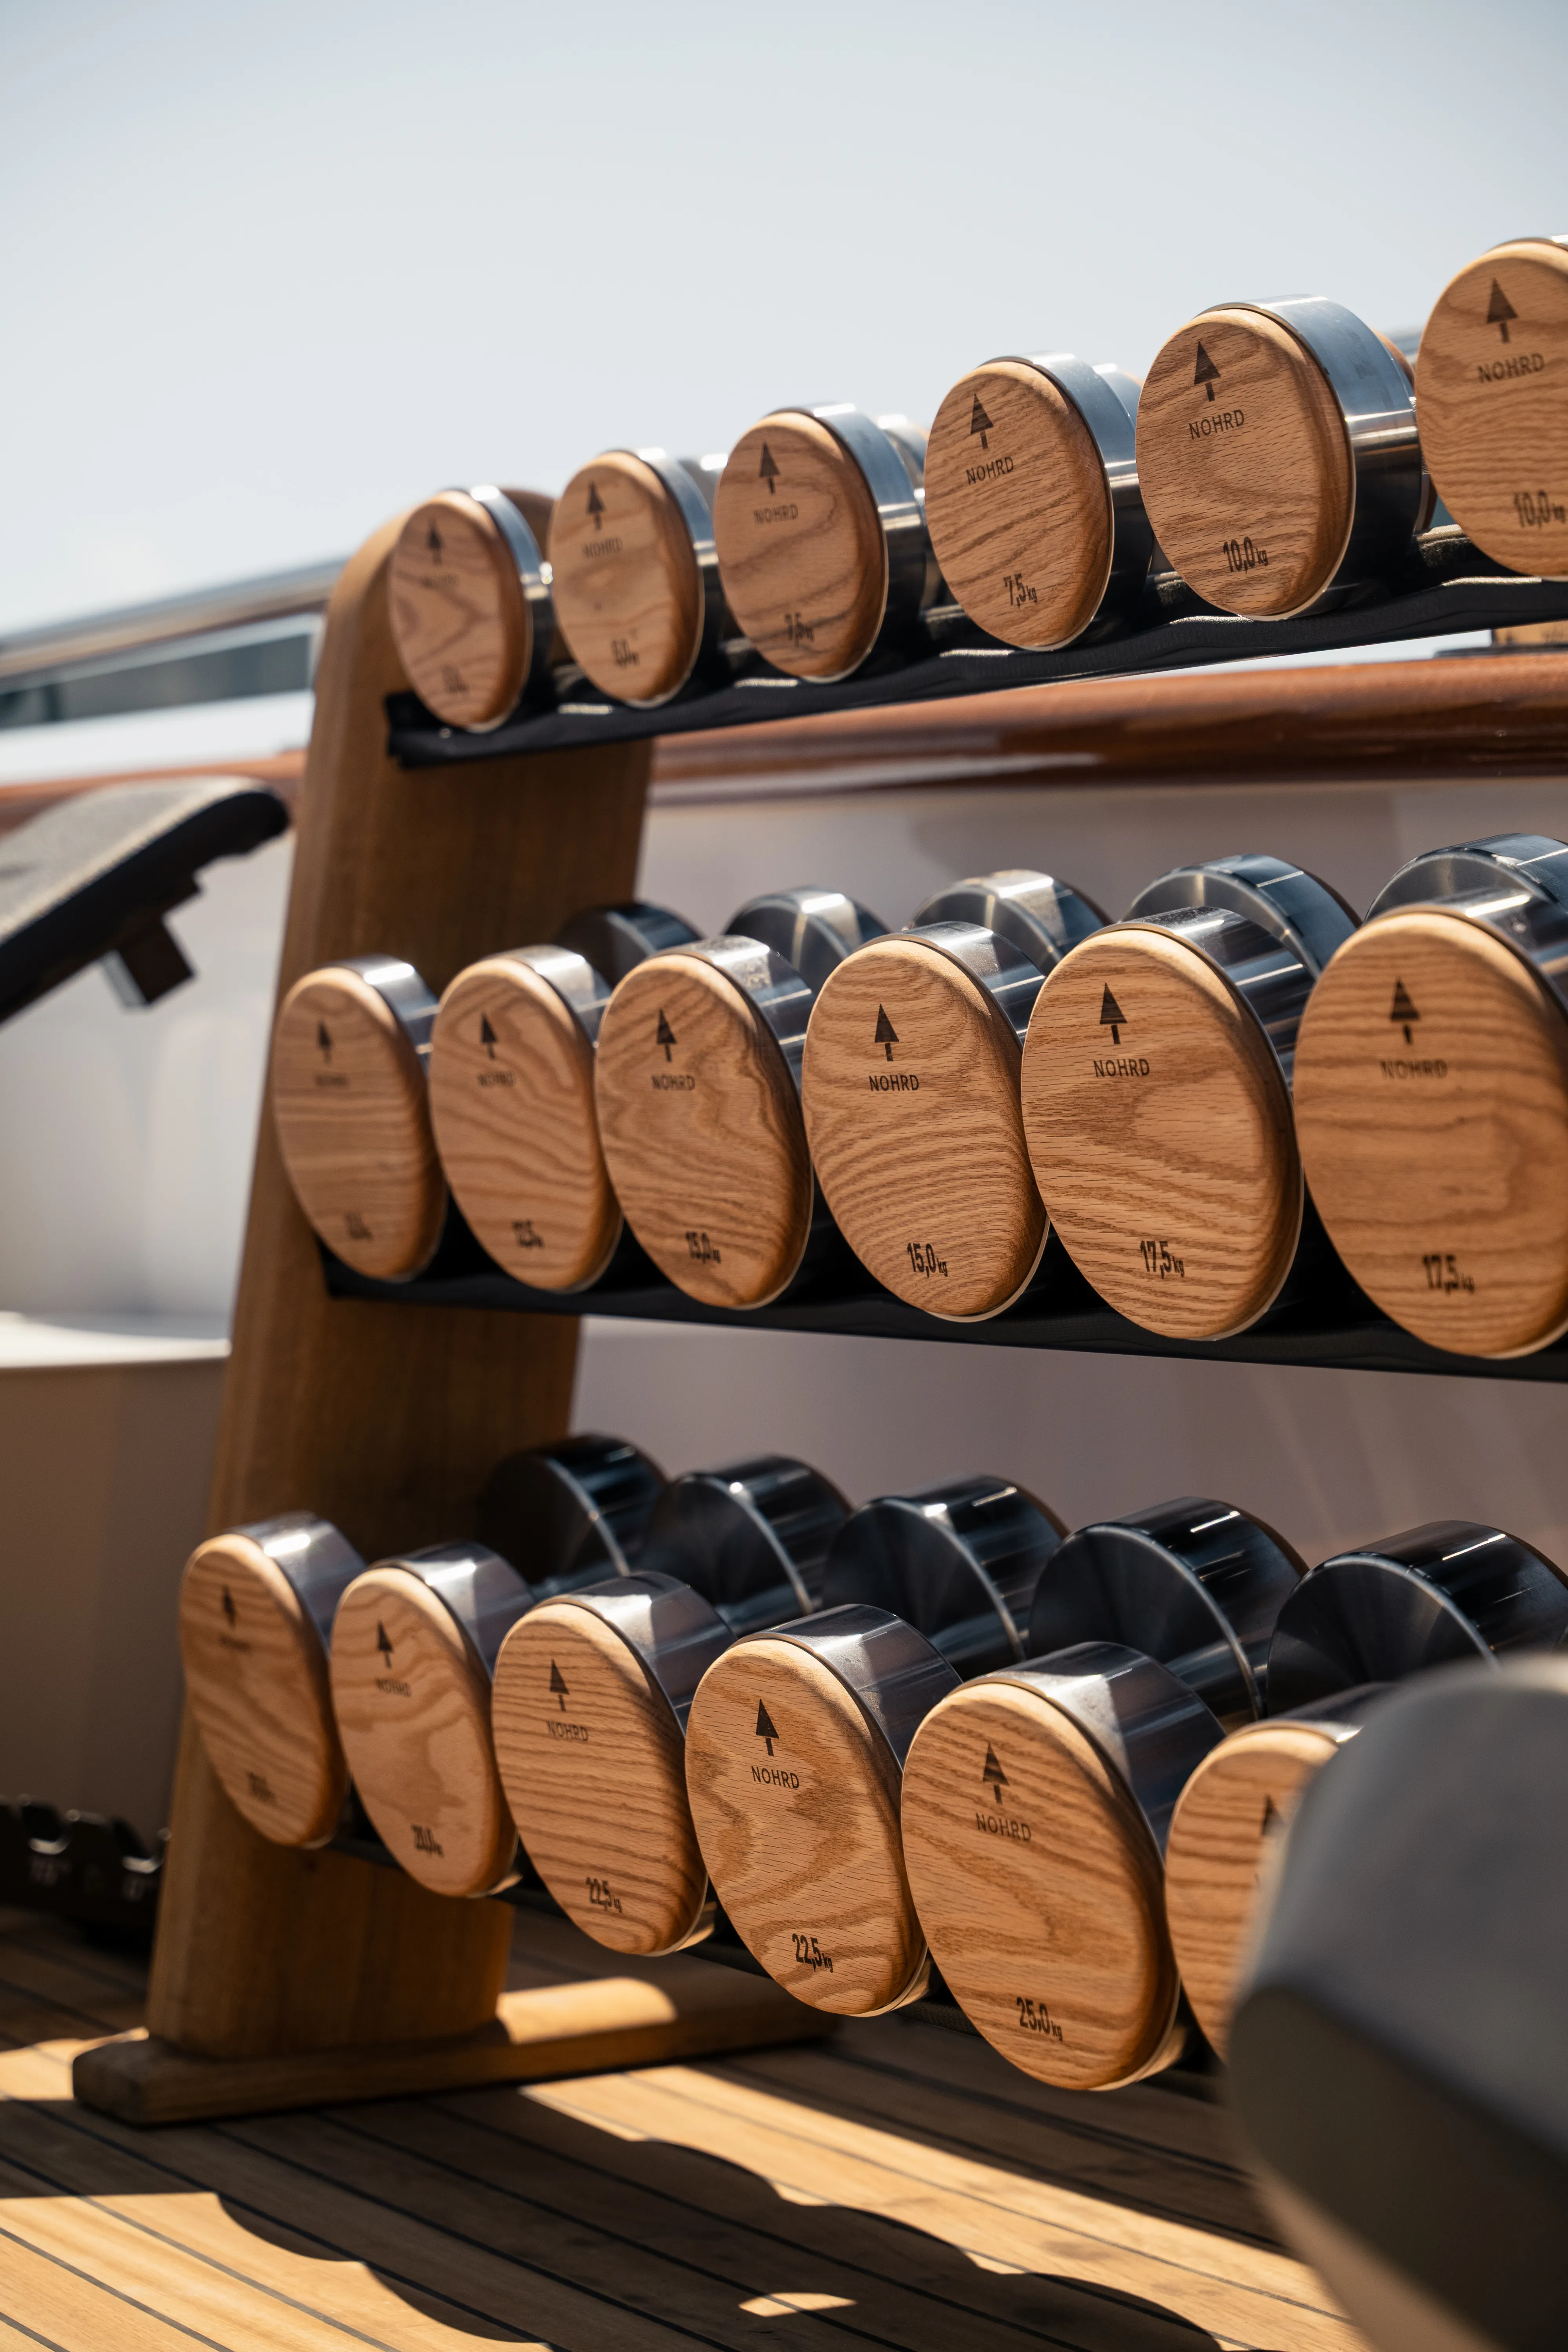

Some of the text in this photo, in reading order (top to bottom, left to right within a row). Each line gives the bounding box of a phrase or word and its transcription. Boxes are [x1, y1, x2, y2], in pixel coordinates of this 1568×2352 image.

[1477, 352, 1544, 383] NOHRD
[1189, 409, 1245, 439] NOHRD
[966, 456, 1014, 485] NOHRD
[753, 503, 799, 524] NOHRD
[1094, 1058, 1150, 1077] NOHRD
[1380, 1059, 1448, 1080] NOHRD
[652, 1074, 695, 1091] NOHRD
[869, 1074, 919, 1092] NOHRD
[546, 1720, 589, 1742] NOHRD
[751, 1766, 799, 1789] NOHRD
[976, 1813, 1031, 1842] NOHRD
